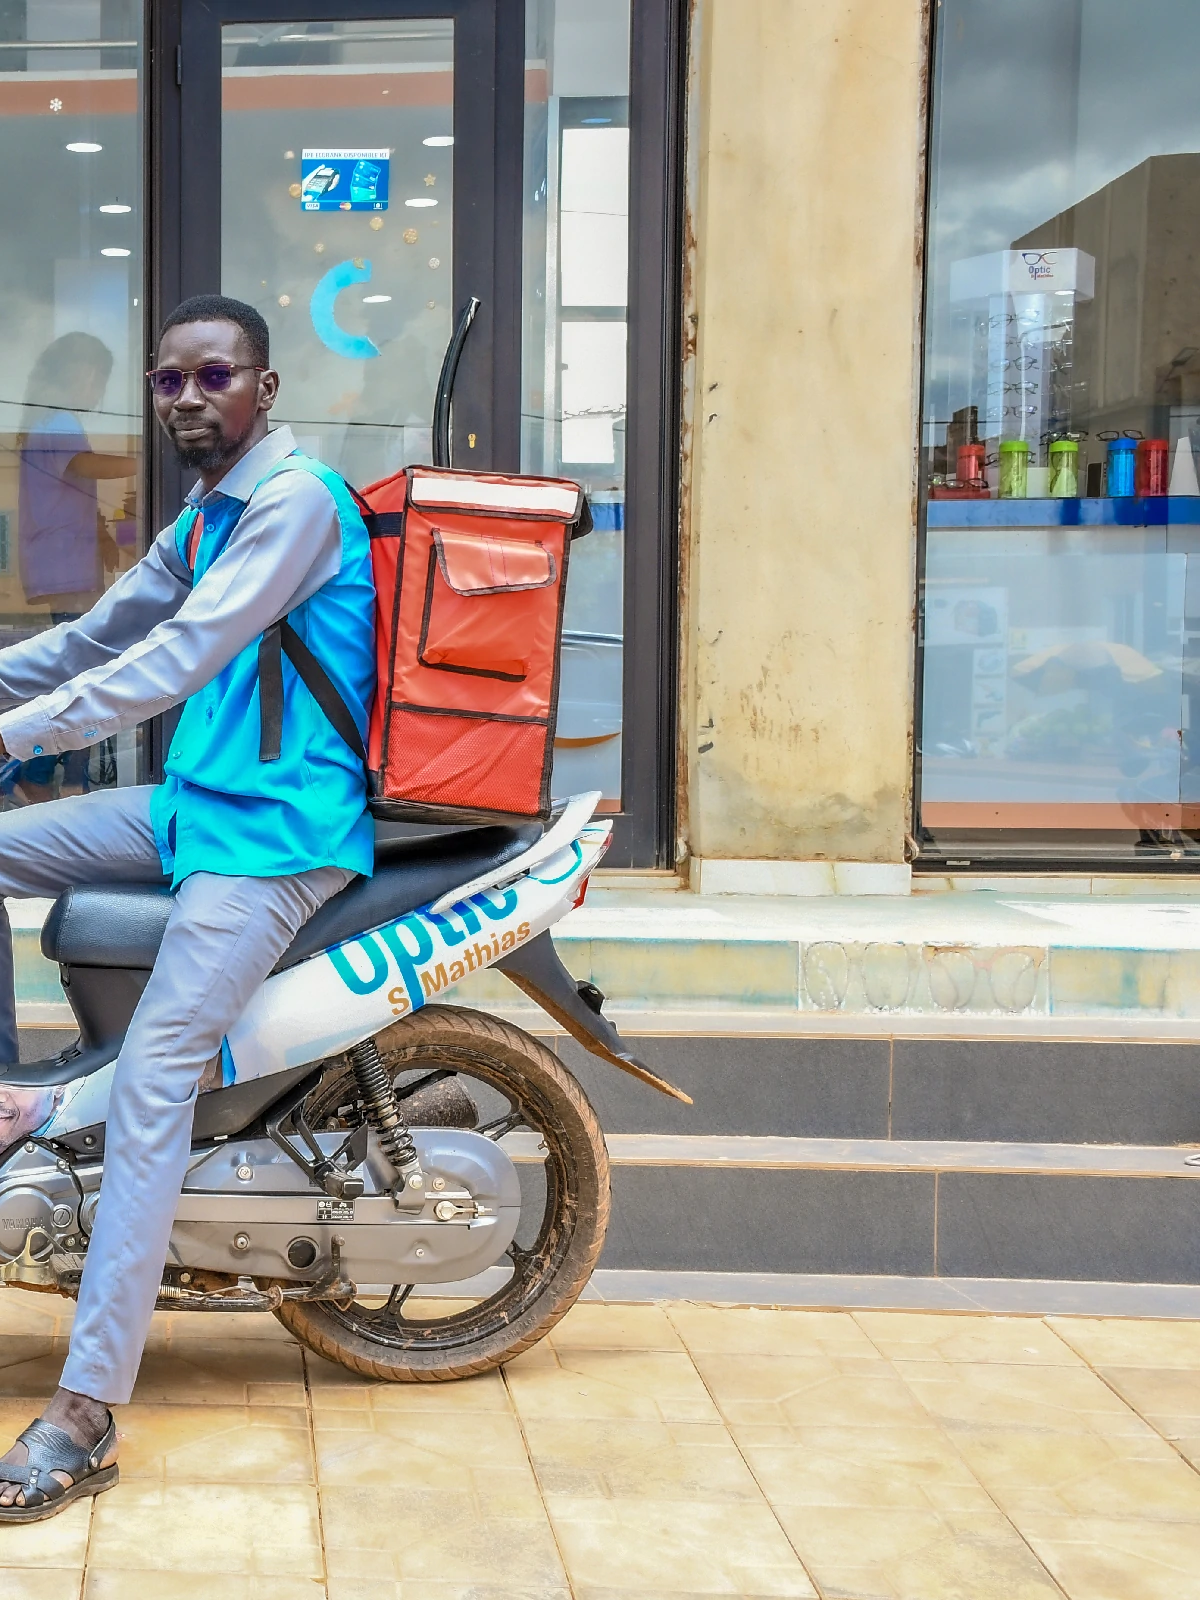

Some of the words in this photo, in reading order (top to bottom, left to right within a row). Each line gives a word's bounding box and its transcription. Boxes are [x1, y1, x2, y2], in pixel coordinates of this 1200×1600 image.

[1029, 266, 1050, 280] Optic
[420, 921, 530, 997] Mathias
[2, 1217, 45, 1230] YAMAHA
